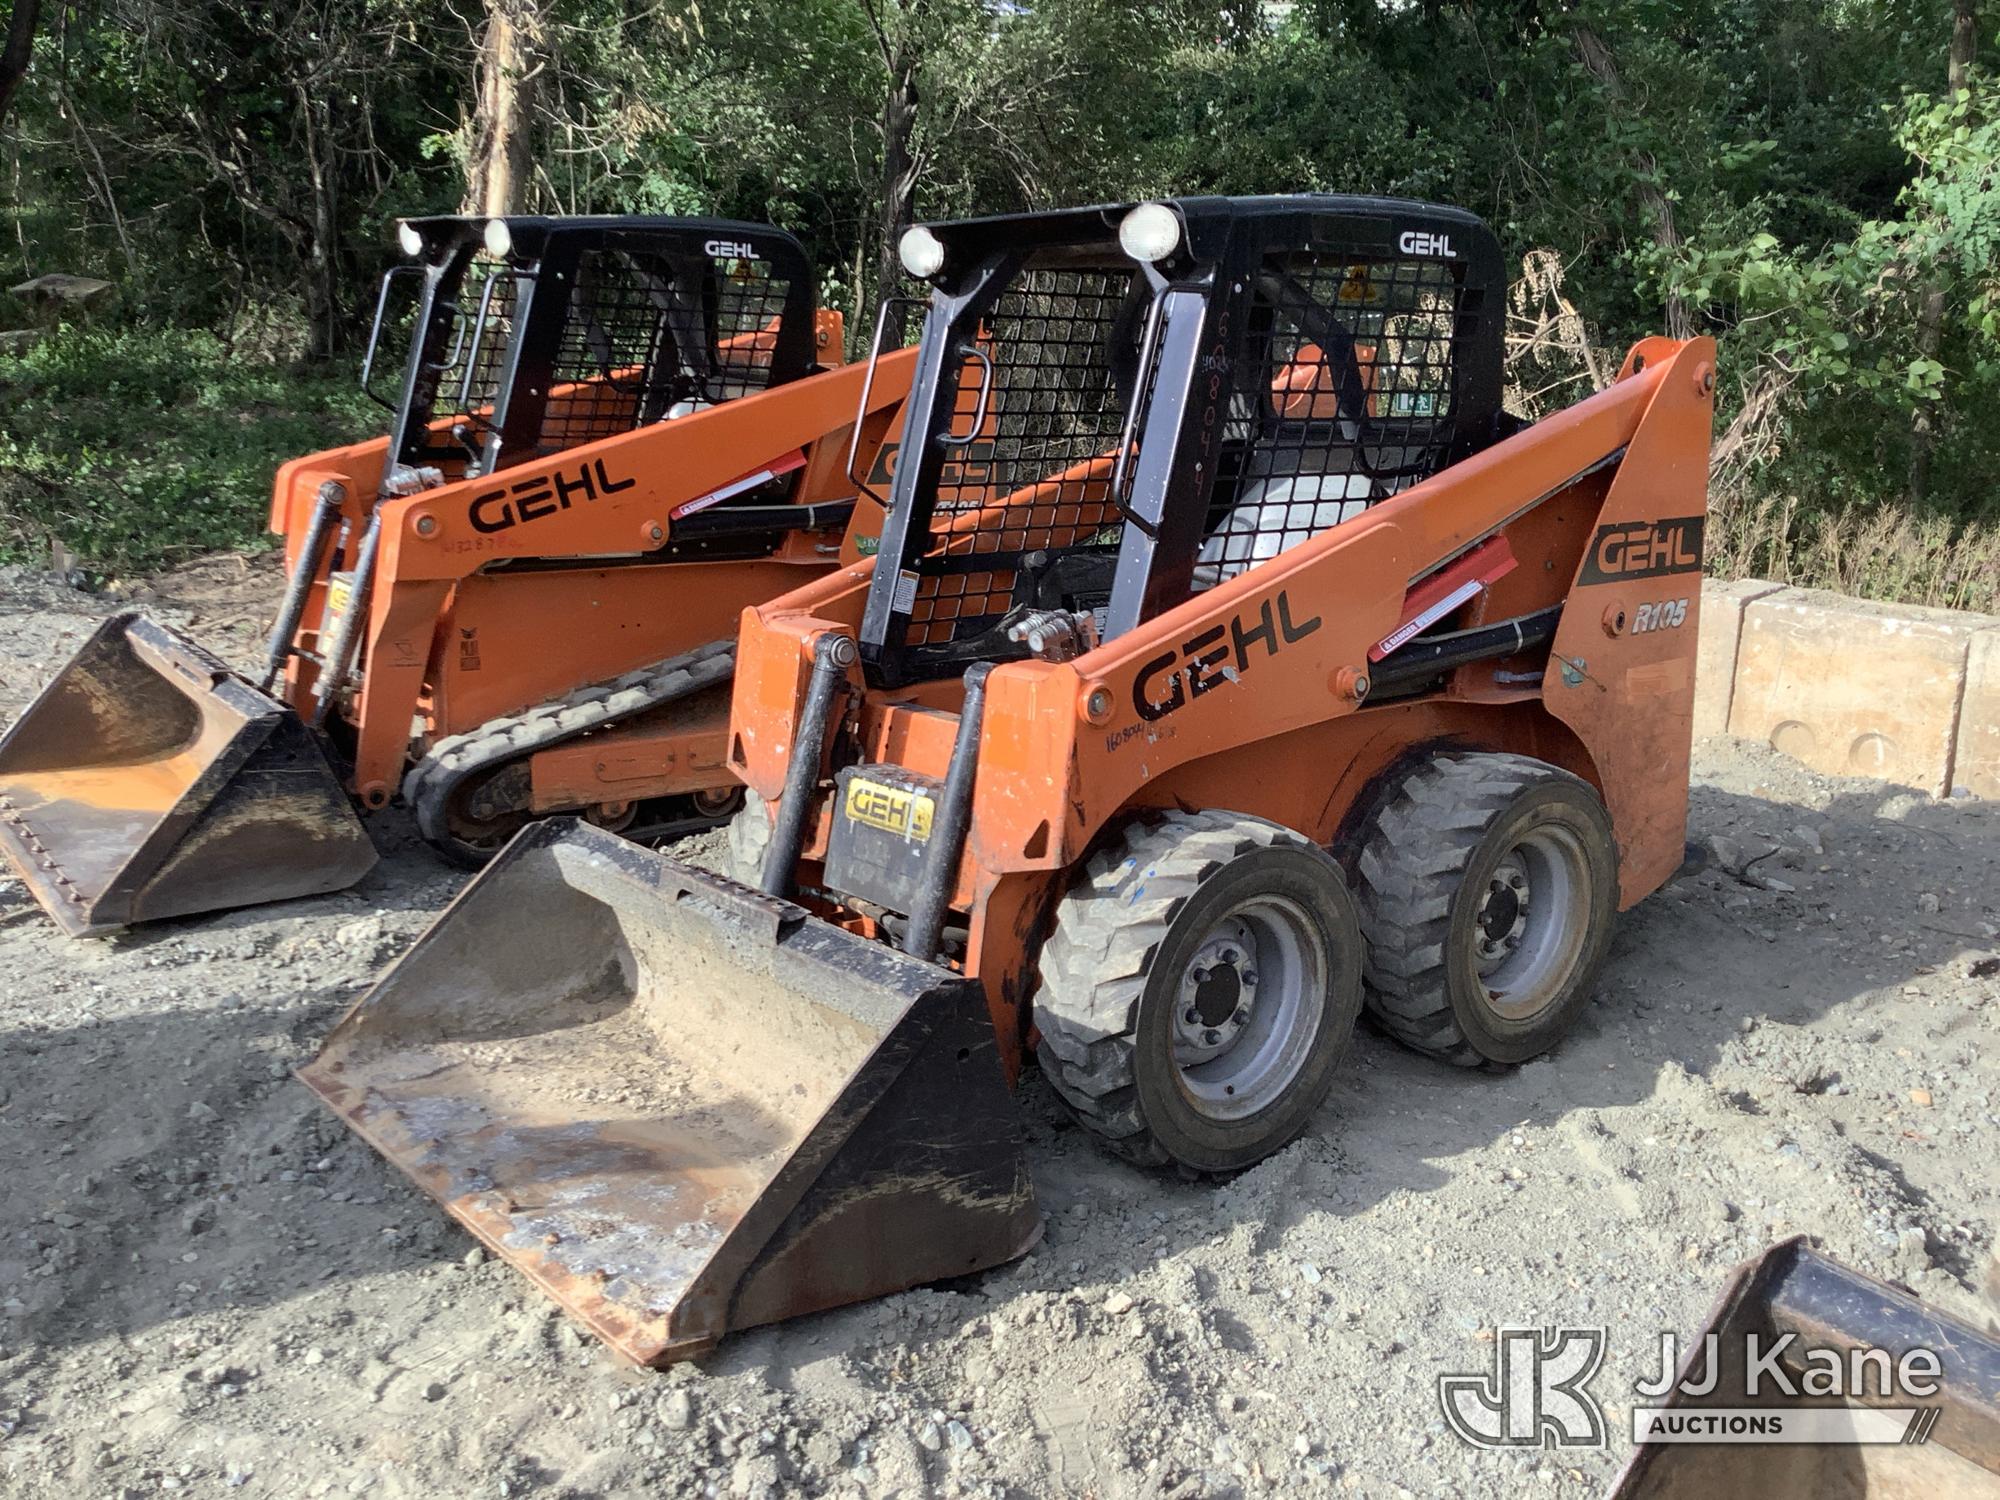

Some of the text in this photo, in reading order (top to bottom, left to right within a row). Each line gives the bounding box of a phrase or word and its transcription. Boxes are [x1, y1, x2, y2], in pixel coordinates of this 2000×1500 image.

[705, 240, 760, 259] GEHL
[1400, 231, 1457, 257] GEHL
[469, 458, 636, 533] GEHL
[1598, 526, 1696, 574] GEHL
[1631, 598, 1689, 635] R105
[1133, 590, 1322, 722] GEHL
[853, 787, 922, 830] GEHL
